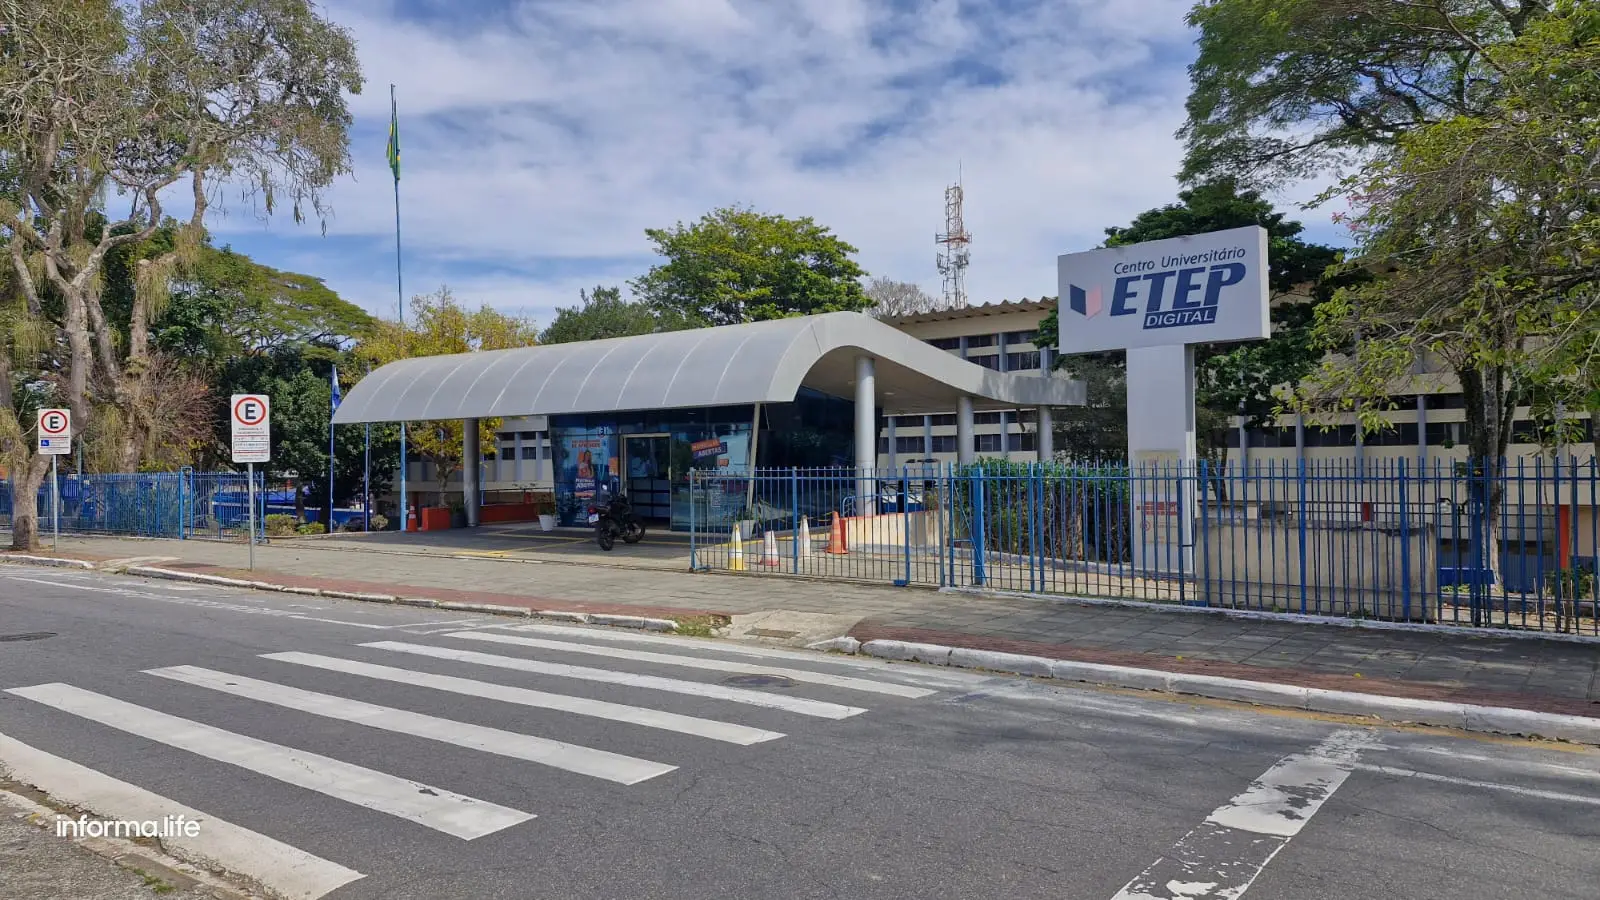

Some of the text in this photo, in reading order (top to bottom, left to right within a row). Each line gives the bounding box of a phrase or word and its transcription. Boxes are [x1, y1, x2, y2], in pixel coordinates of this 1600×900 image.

[1114, 246, 1246, 275] Centro Universitário
[1110, 262, 1246, 316] ETEP
[1146, 311, 1214, 327] DIGITAL
[245, 403, 256, 419] E
[50, 416, 59, 429] E
